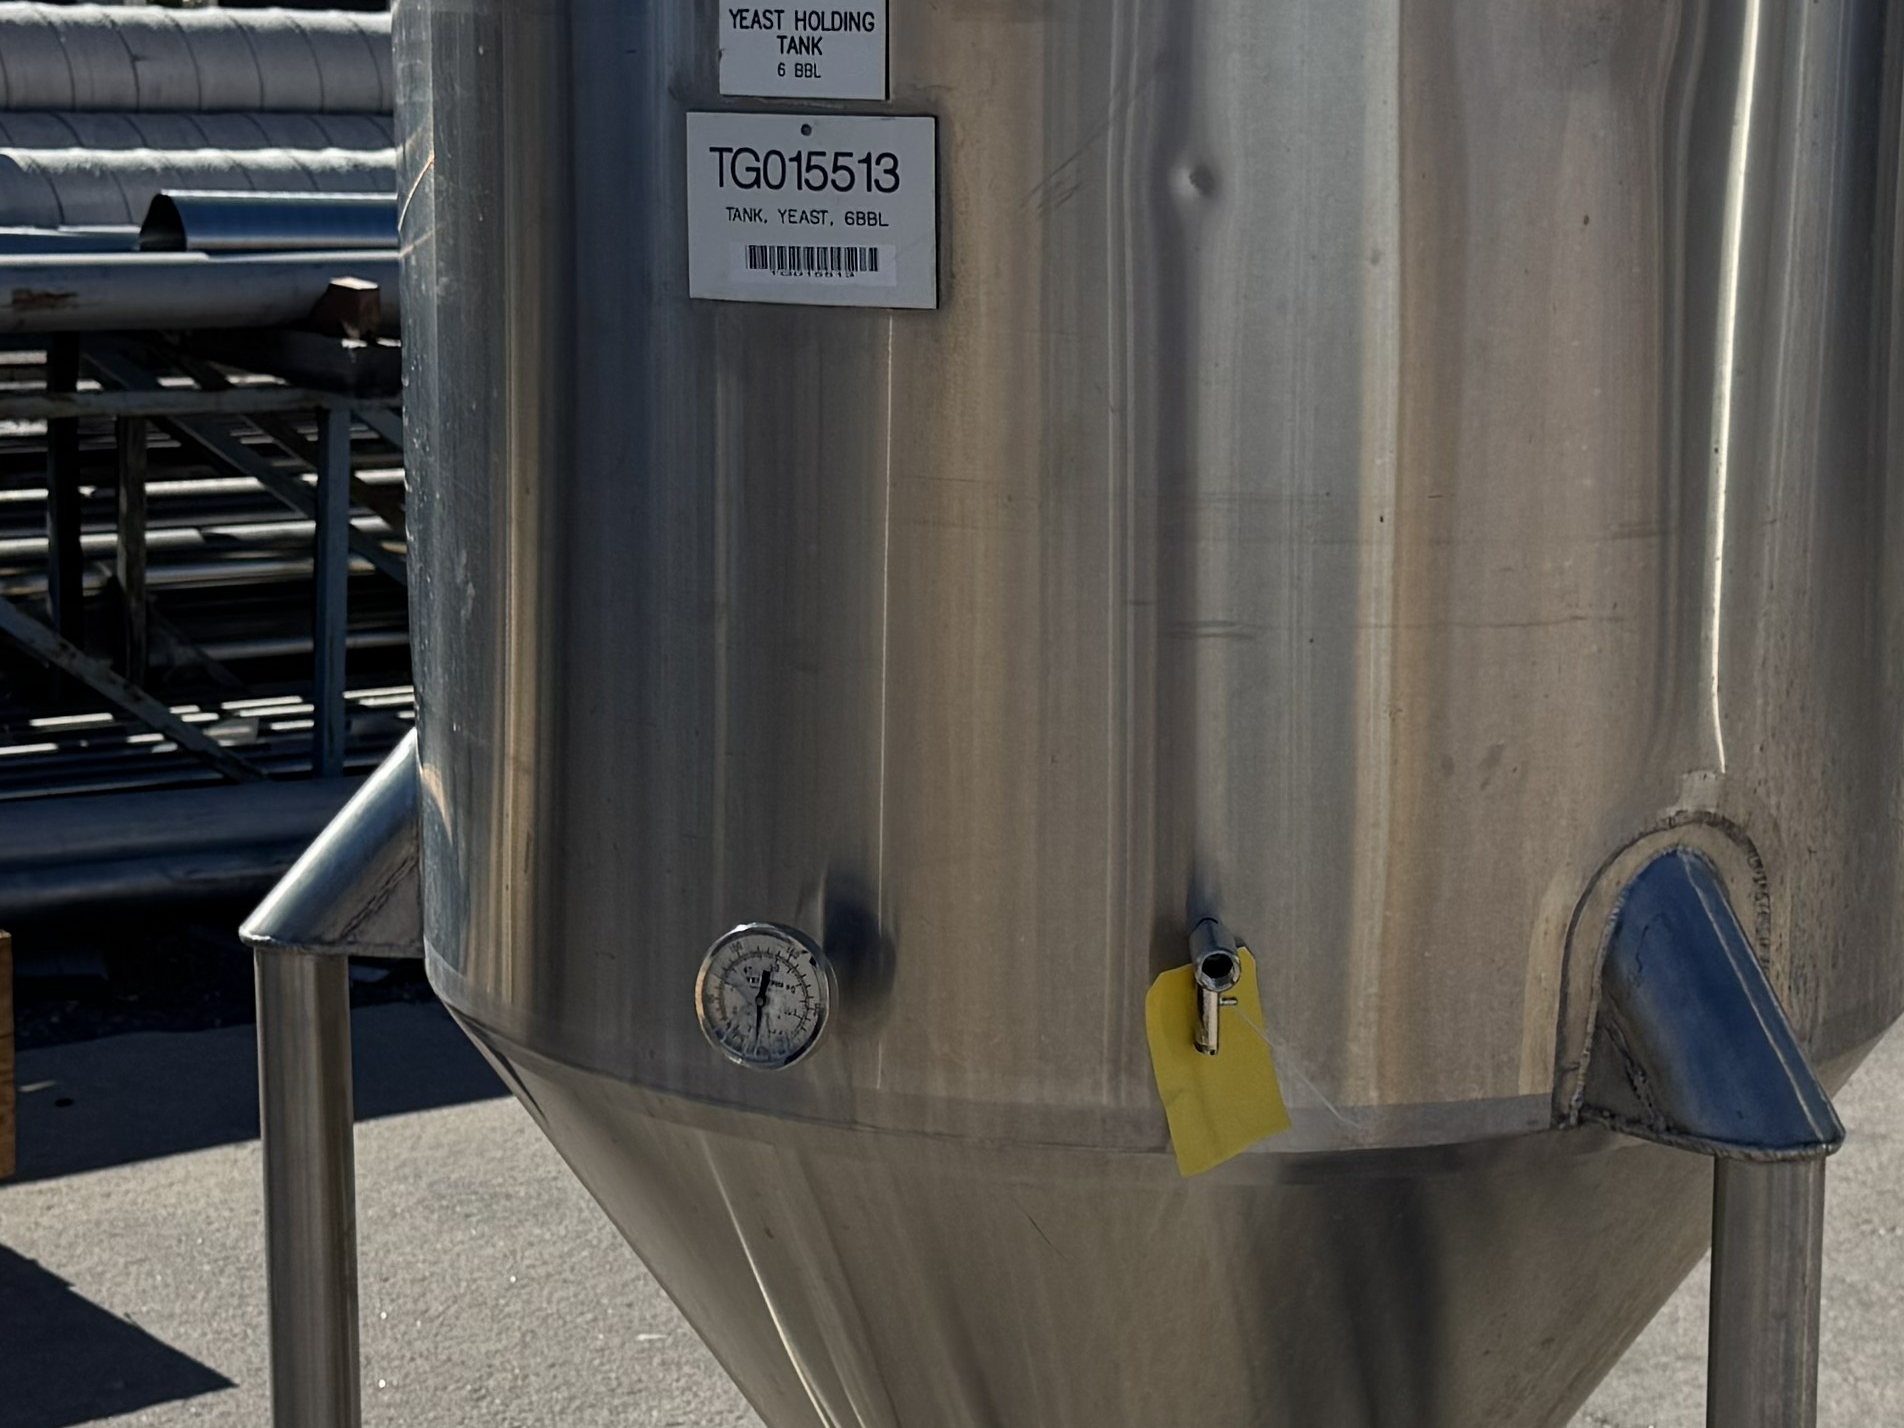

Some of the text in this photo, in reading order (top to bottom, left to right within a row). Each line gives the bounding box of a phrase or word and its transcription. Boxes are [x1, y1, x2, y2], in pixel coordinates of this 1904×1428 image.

[729, 8, 875, 32] YEAST HOLDING
[776, 35, 823, 56] TANK
[777, 62, 822, 79] 6 BBL
[709, 146, 901, 194] TG015513
[844, 210, 889, 227] 6BBL
